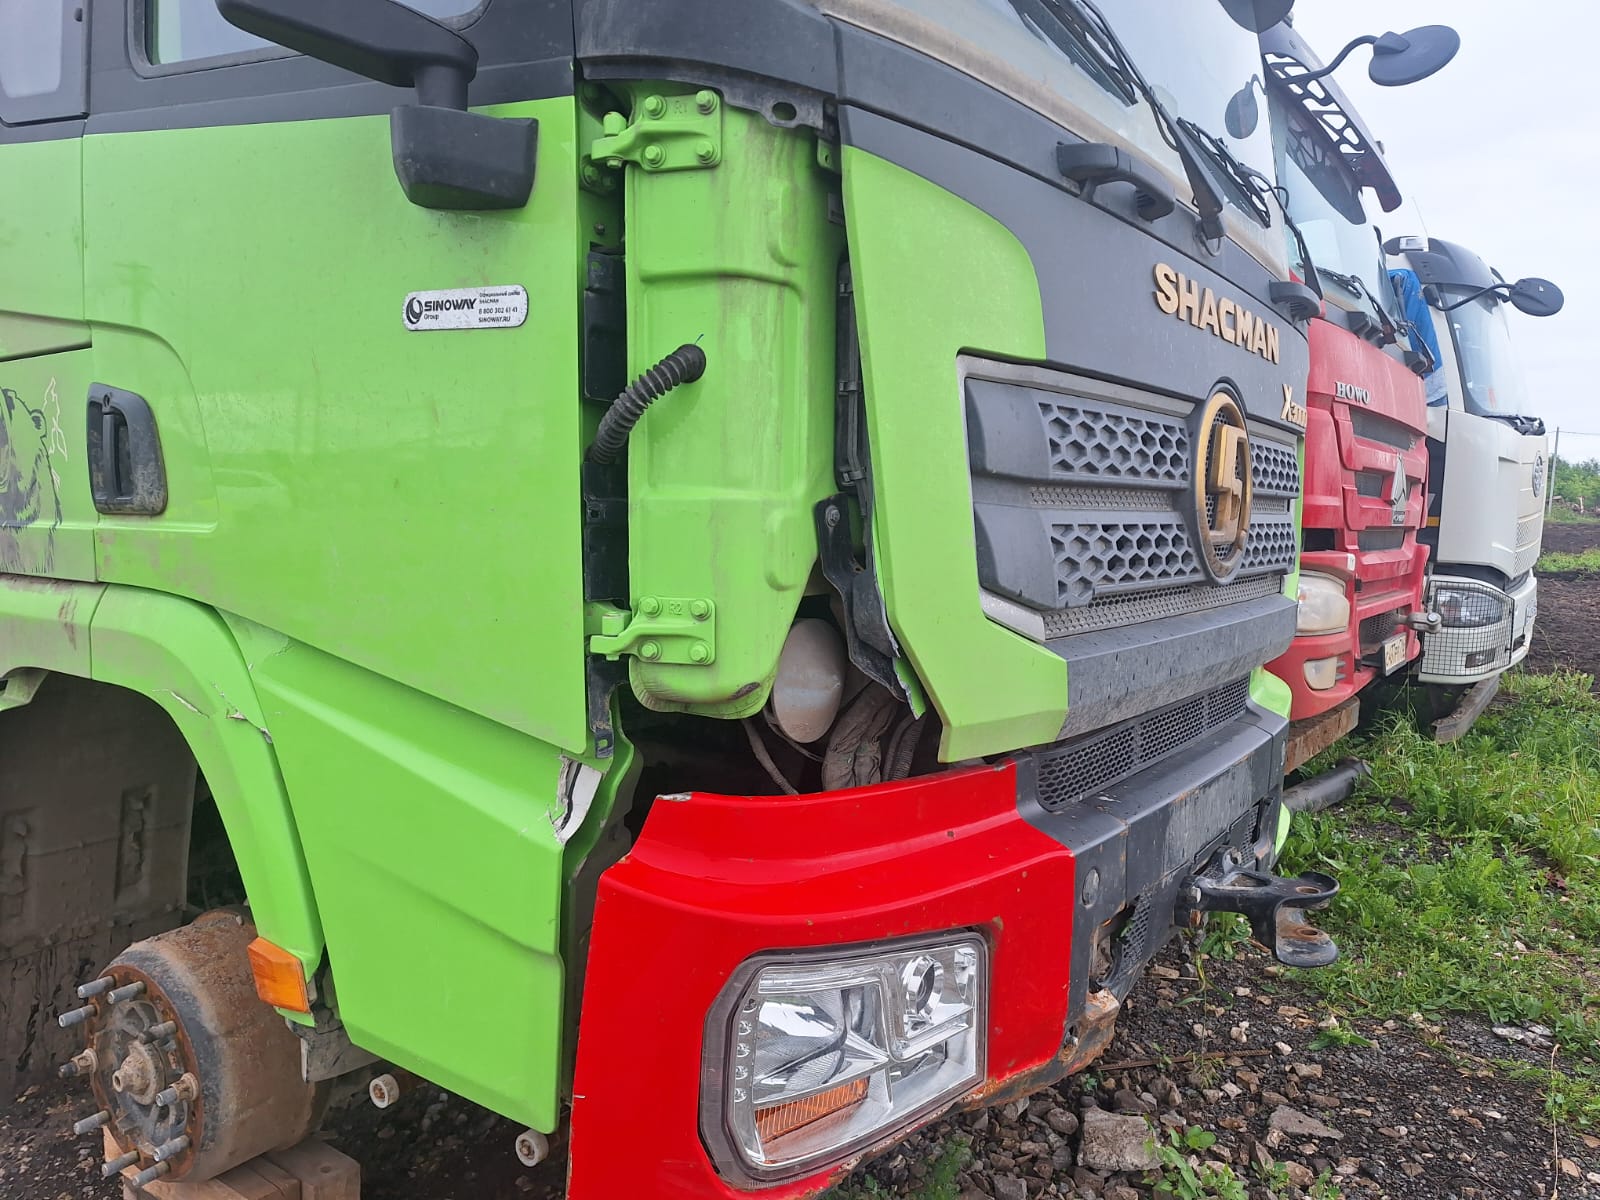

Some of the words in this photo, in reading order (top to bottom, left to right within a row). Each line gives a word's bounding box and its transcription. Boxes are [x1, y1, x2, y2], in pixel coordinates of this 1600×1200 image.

[424, 298, 477, 312] SINOWAY
[1153, 262, 1280, 365] SHACMAN
[1335, 381, 1370, 405] HOWO
